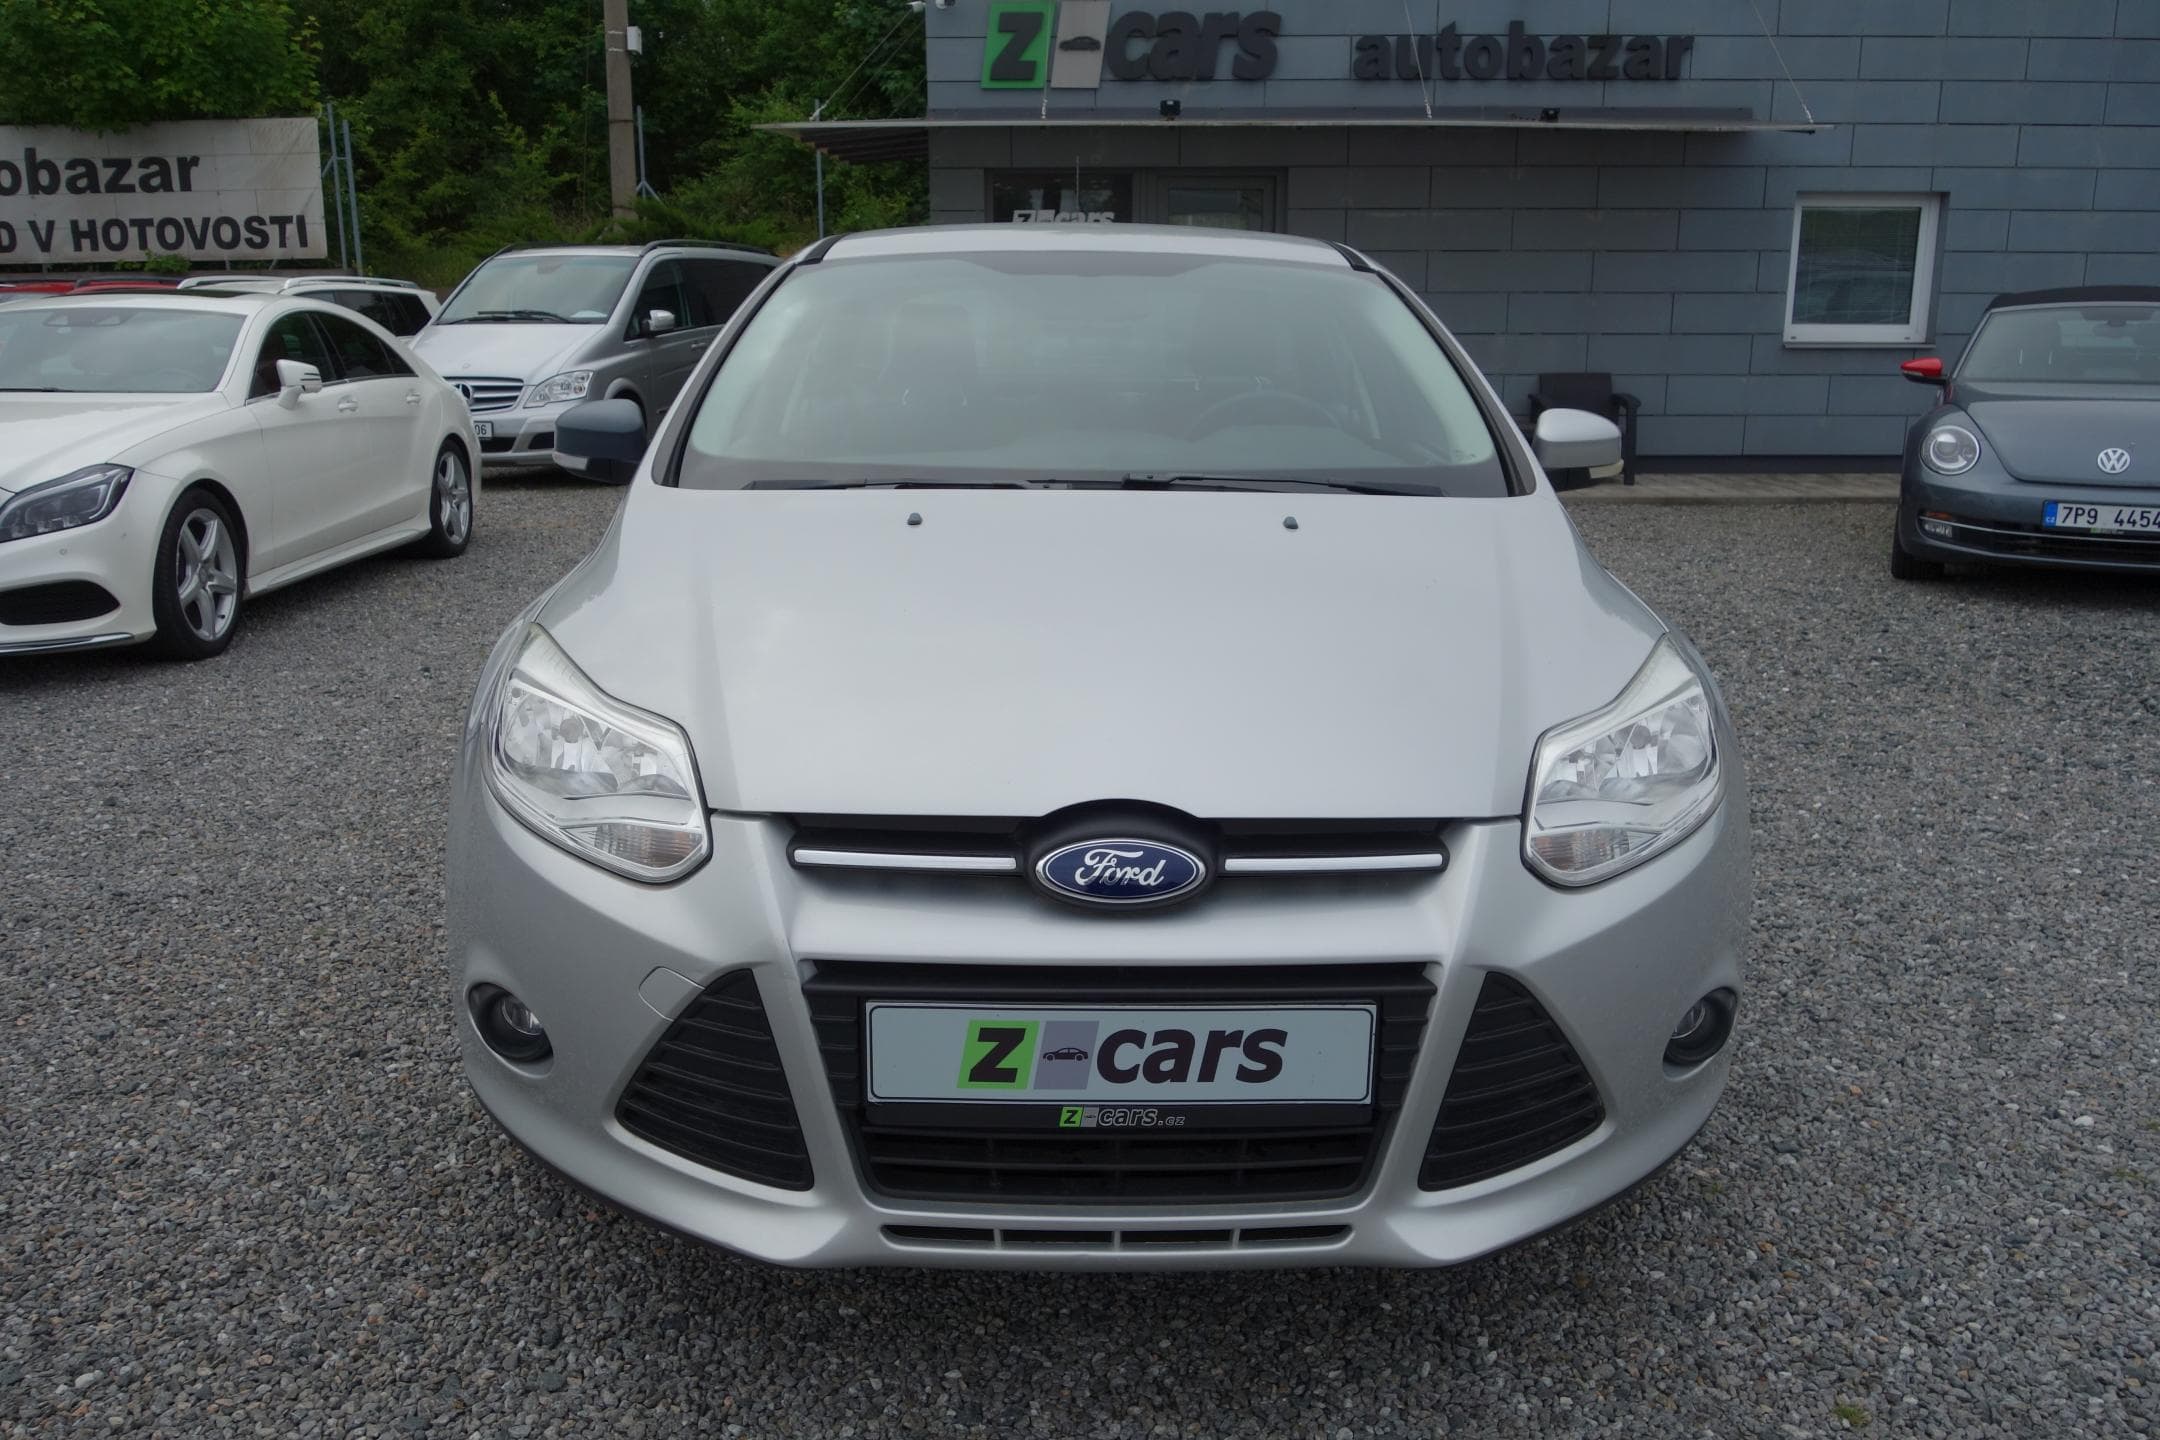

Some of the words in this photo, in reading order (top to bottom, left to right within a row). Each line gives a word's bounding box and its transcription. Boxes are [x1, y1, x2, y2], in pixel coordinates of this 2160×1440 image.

[1106, 10, 1282, 81] cars
[1352, 20, 1695, 81] autobazar
[0, 147, 200, 196] obazar
[28, 220, 55, 253] V
[70, 214, 309, 252] HOTOVOSTI
[2062, 506, 2098, 525] 7P9
[1074, 848, 1167, 887] Ford
[1097, 1028, 1288, 1084] cars
